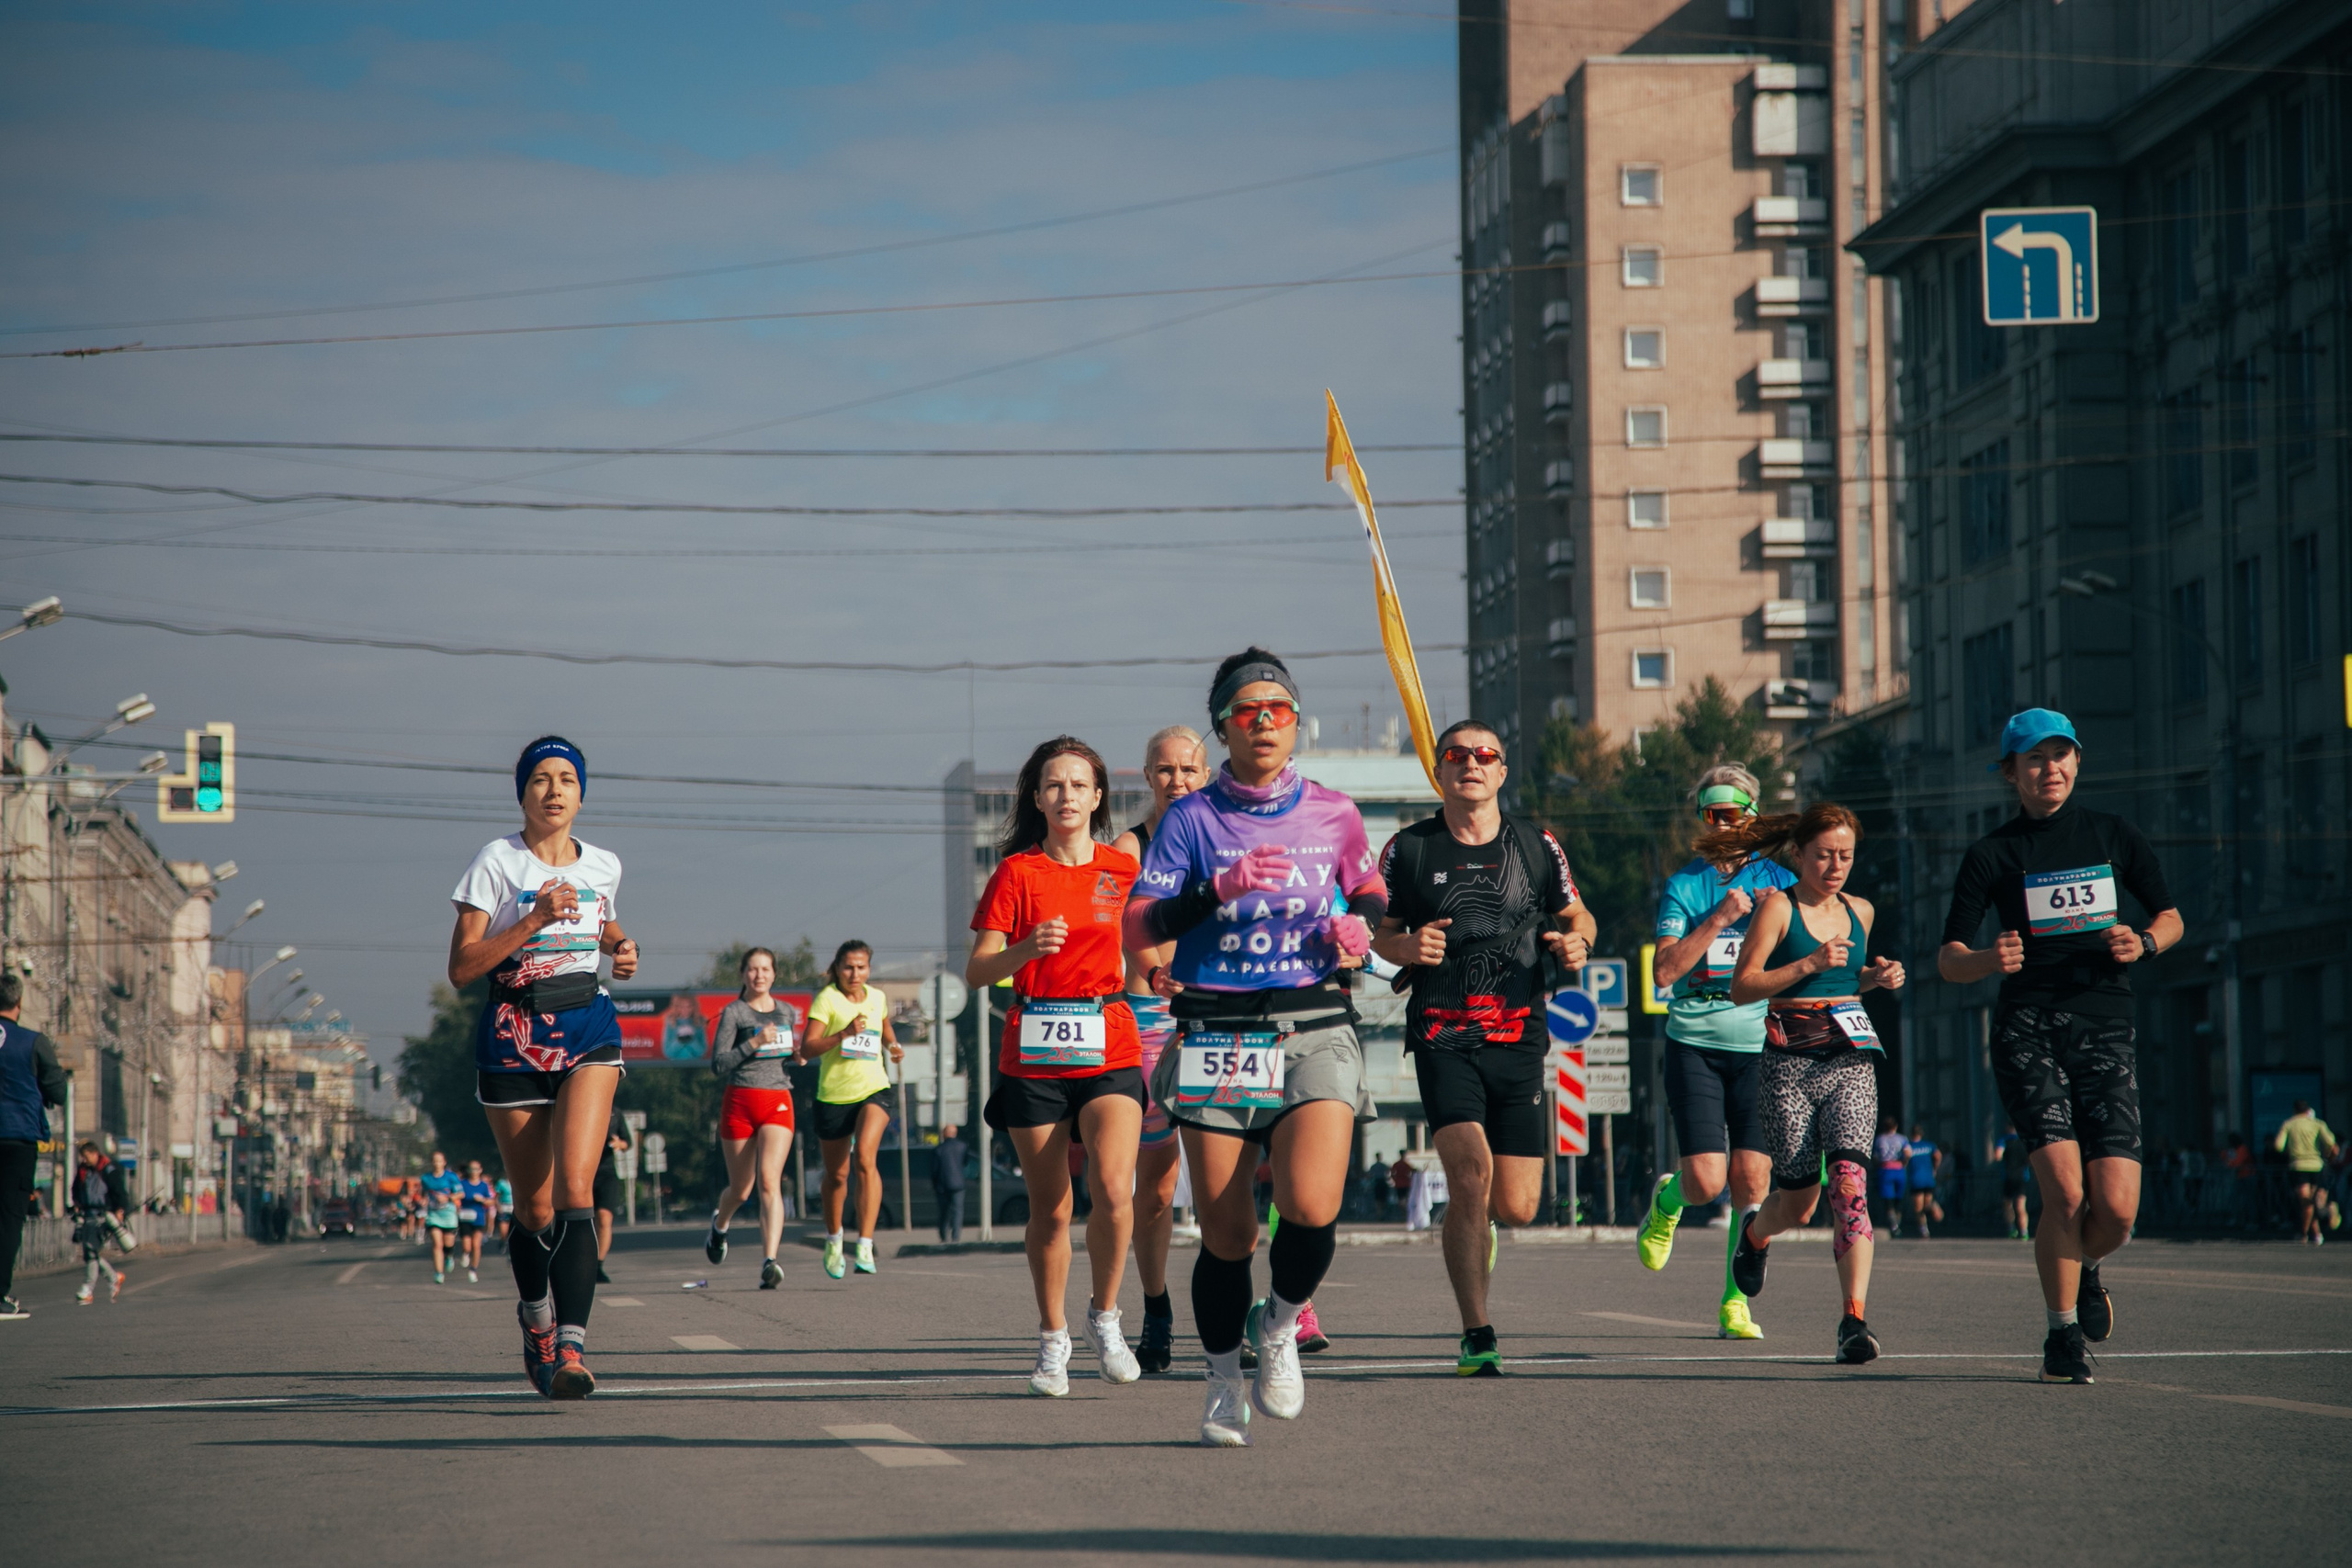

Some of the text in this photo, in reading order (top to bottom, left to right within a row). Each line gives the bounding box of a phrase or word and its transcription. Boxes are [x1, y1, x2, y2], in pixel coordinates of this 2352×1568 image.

[1302, 846, 1333, 855] БЕЖИТ
[2050, 884, 2096, 909] 613
[1216, 897, 1329, 922] МАРА
[1219, 931, 1302, 954] ФОН
[1590, 966, 1616, 1001] P
[1041, 1021, 1085, 1042] 781
[1204, 1051, 1260, 1077] 554
[2042, 1113, 2064, 1123] NEVER
[2046, 1107, 2063, 1117] GIVE
